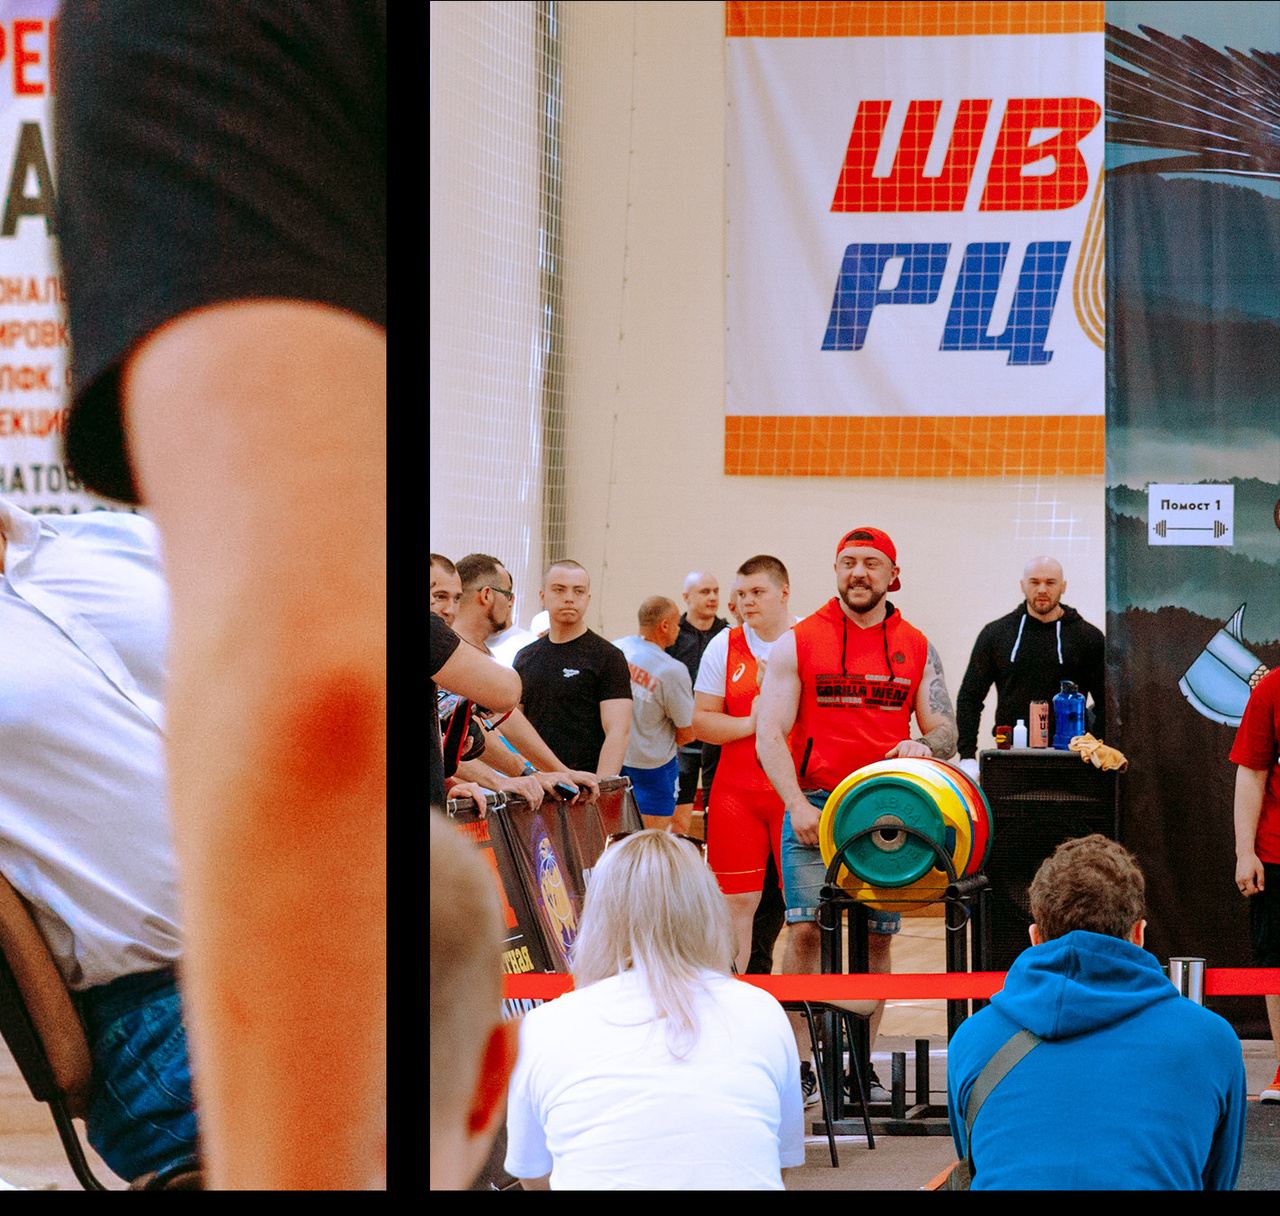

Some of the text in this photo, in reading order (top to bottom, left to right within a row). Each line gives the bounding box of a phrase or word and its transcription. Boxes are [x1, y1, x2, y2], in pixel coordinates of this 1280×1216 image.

[830, 98, 1103, 213] ШВ
[821, 241, 1072, 366] РЦ
[1161, 499, 1221, 511] Помост 1
[816, 686, 867, 698] GORILLA
